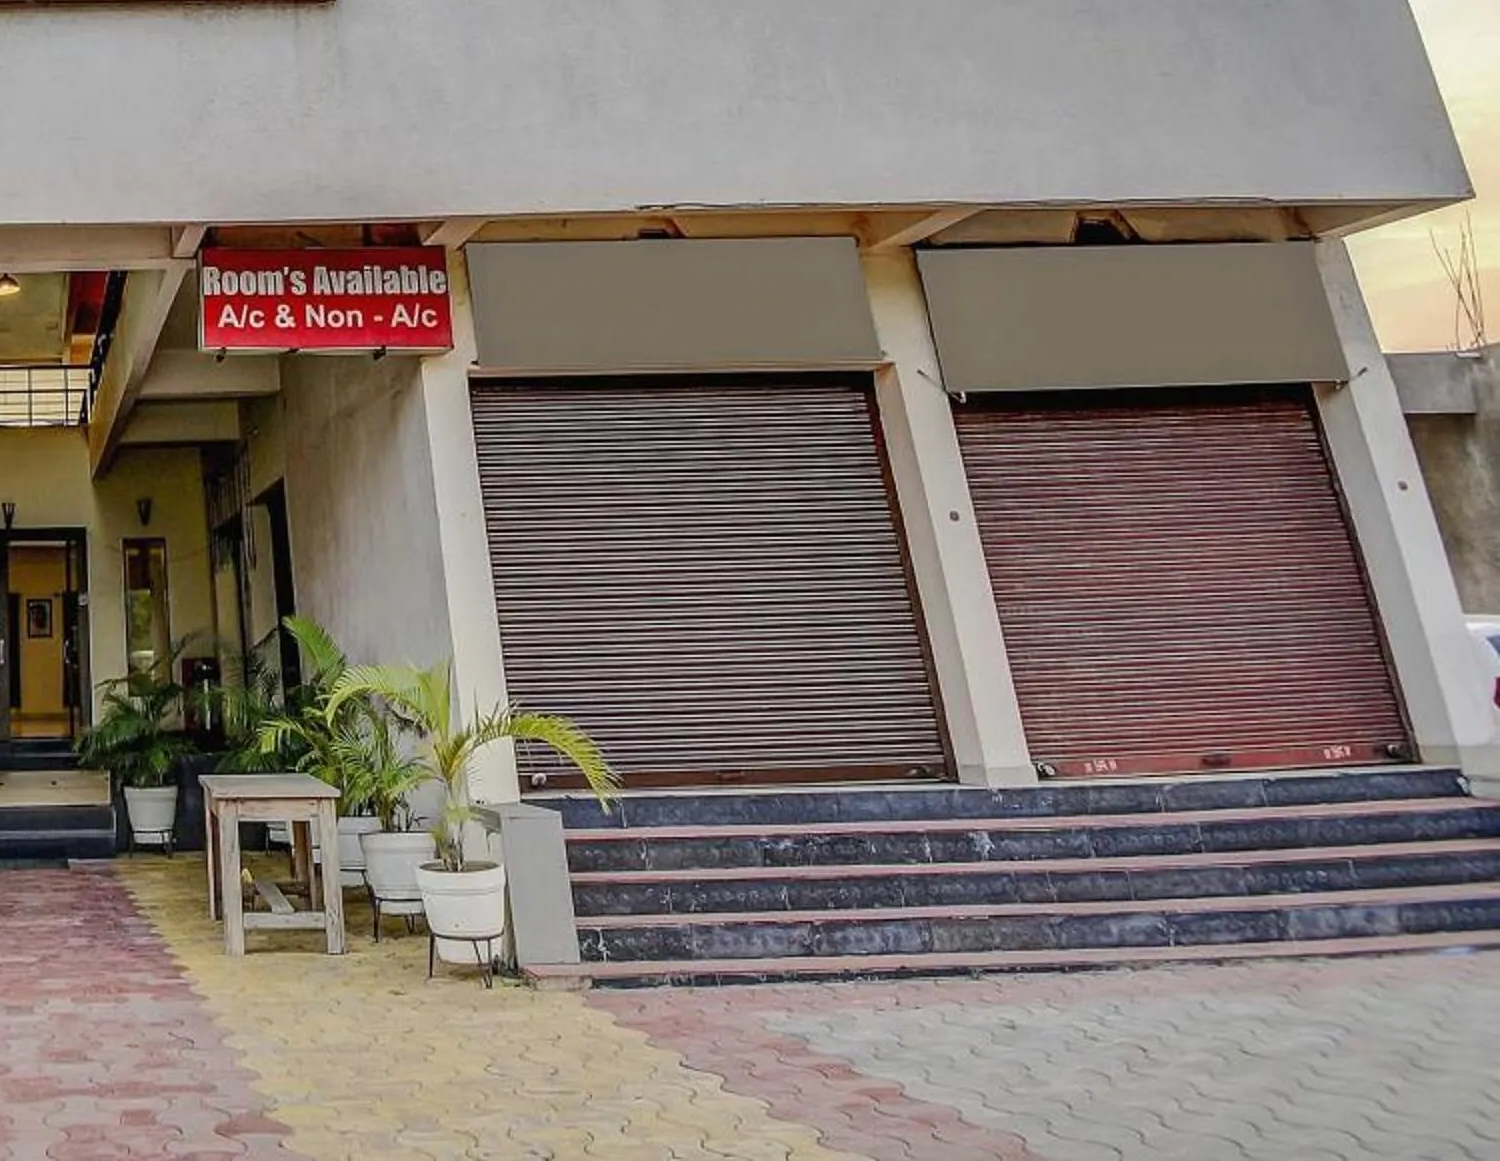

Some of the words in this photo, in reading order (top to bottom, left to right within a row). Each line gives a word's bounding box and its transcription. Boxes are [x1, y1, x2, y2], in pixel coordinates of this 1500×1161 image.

[203, 266, 307, 296] Room's
[313, 265, 447, 295] Available
[218, 304, 265, 328] A/c
[274, 305, 296, 328] &
[305, 304, 363, 328] Non
[391, 303, 438, 328] A/c
